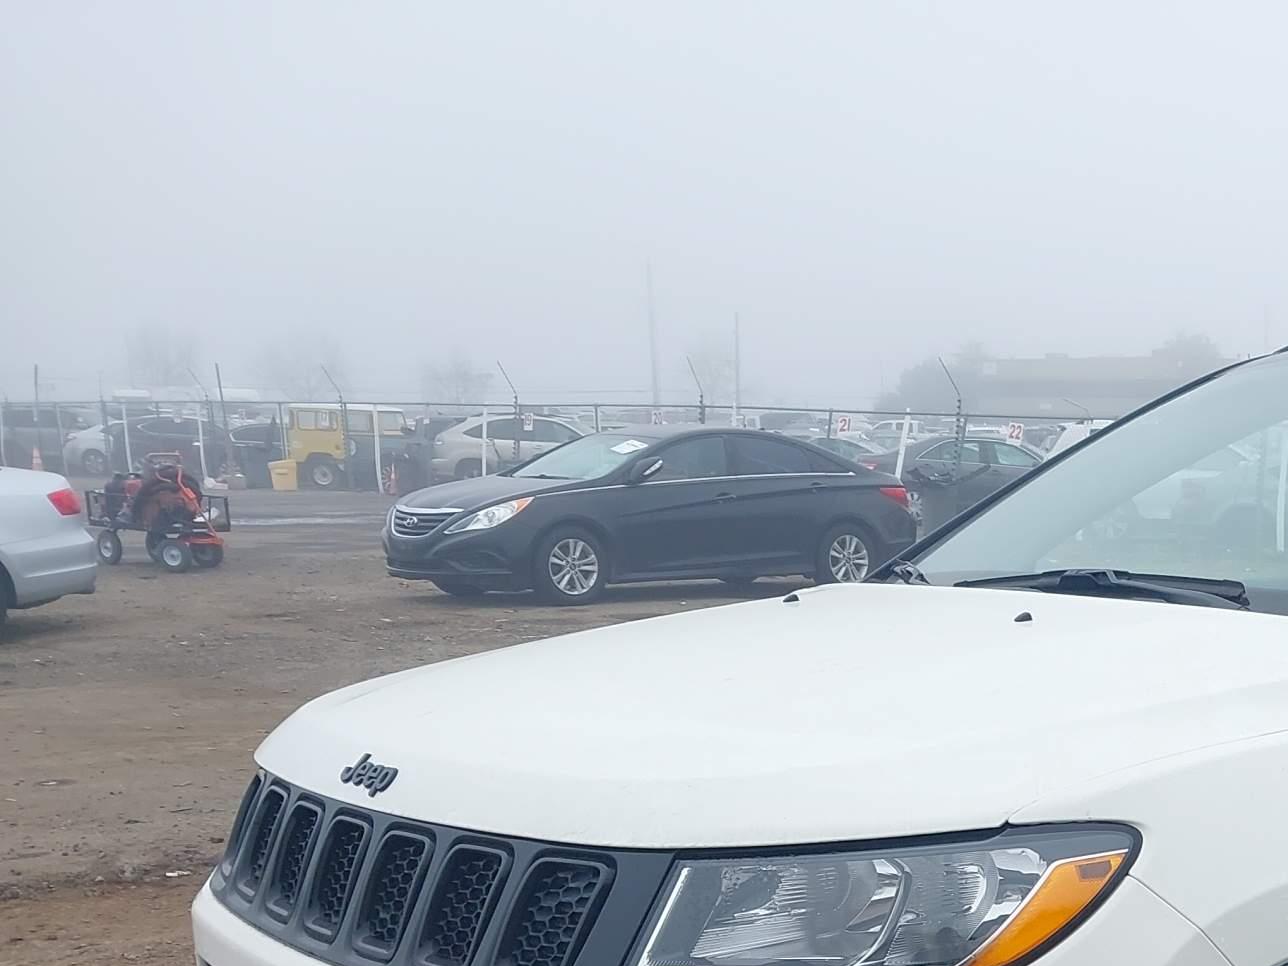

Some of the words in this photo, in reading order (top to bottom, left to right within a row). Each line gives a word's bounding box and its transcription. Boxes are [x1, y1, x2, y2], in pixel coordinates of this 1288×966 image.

[838, 418, 851, 433] 21
[1008, 424, 1022, 440] 22
[340, 752, 398, 798] Jeep
